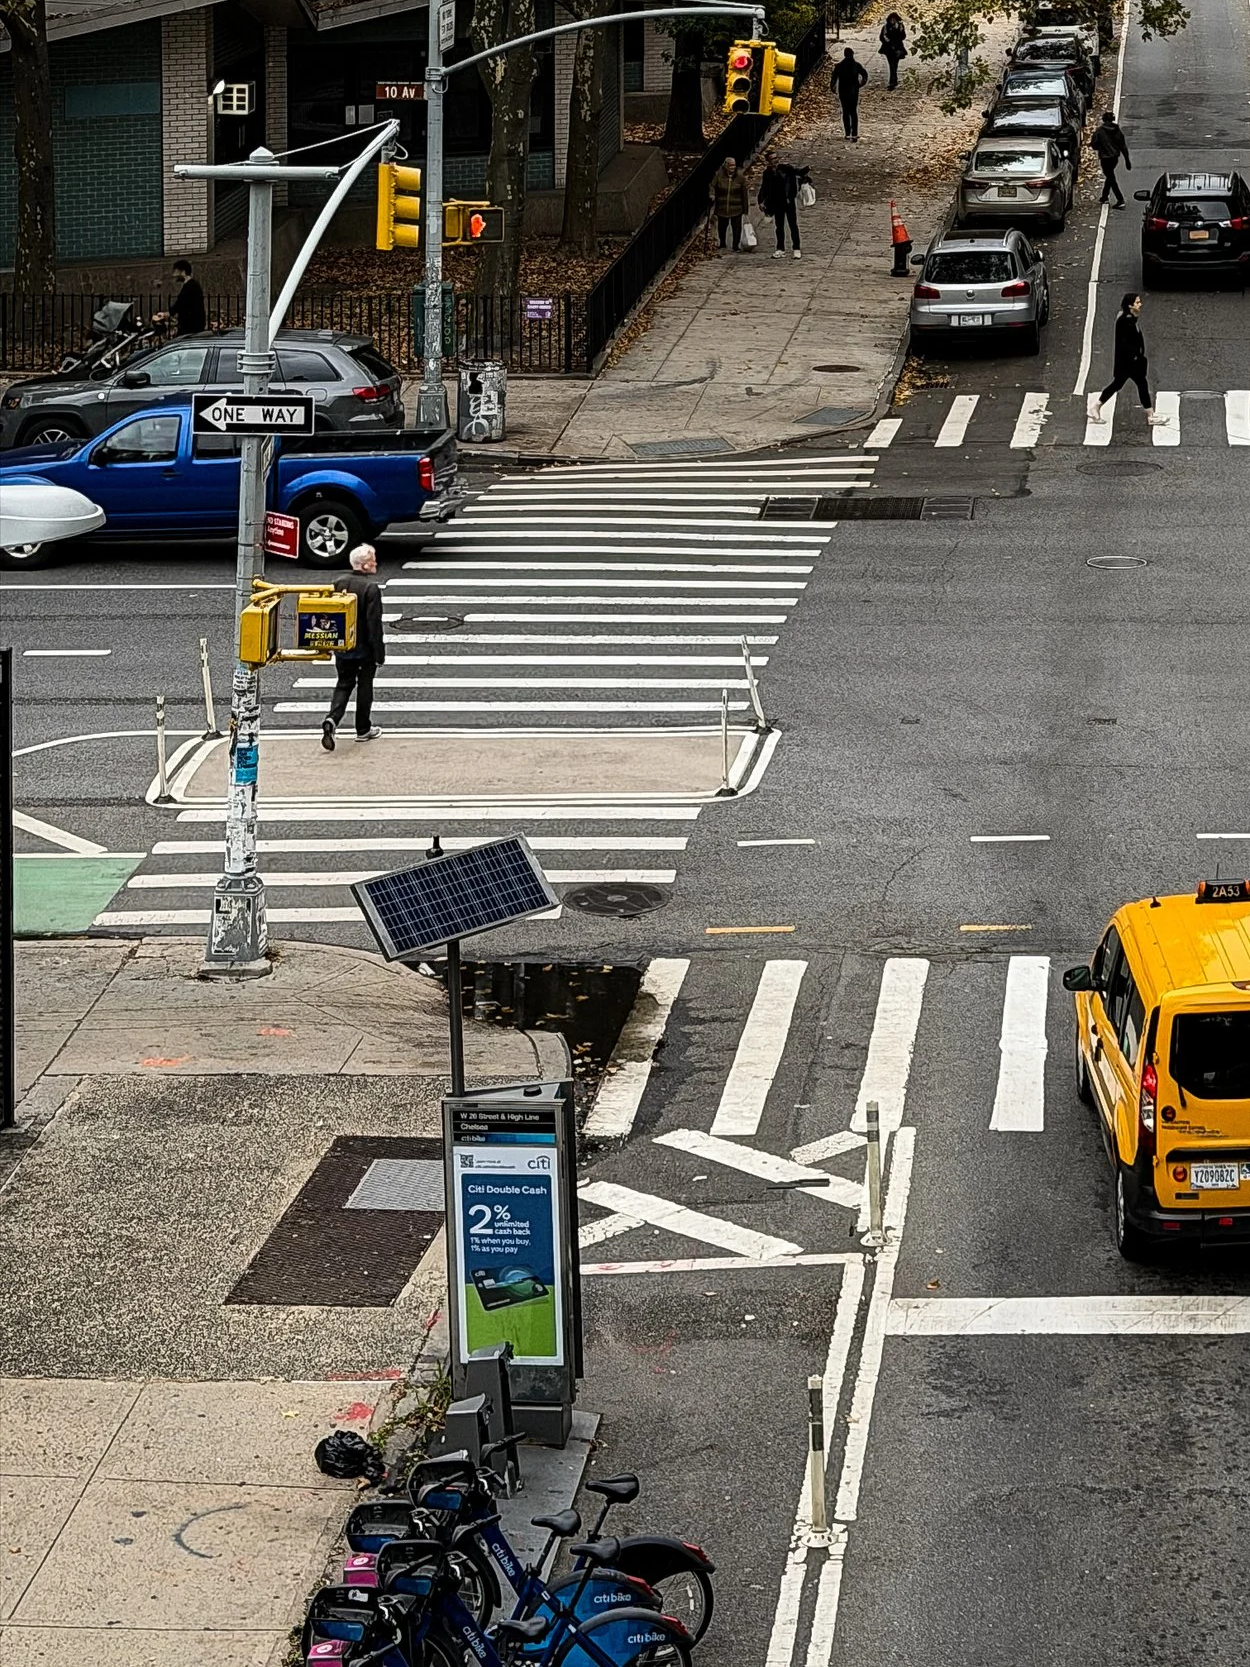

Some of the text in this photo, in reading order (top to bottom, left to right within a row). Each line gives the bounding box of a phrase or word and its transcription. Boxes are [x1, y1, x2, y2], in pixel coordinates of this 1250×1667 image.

[385, 86, 415, 98] 10 Av
[212, 407, 297, 422] ONE WAY
[1212, 885, 1240, 897] 2A53
[507, 1114, 523, 1122] High
[460, 1123, 488, 1131] Chelsea
[527, 1155, 551, 1170] citi
[468, 1185, 547, 1194] Citi Double Cash
[491, 1246, 504, 1254] you
[505, 1246, 518, 1254] pay
